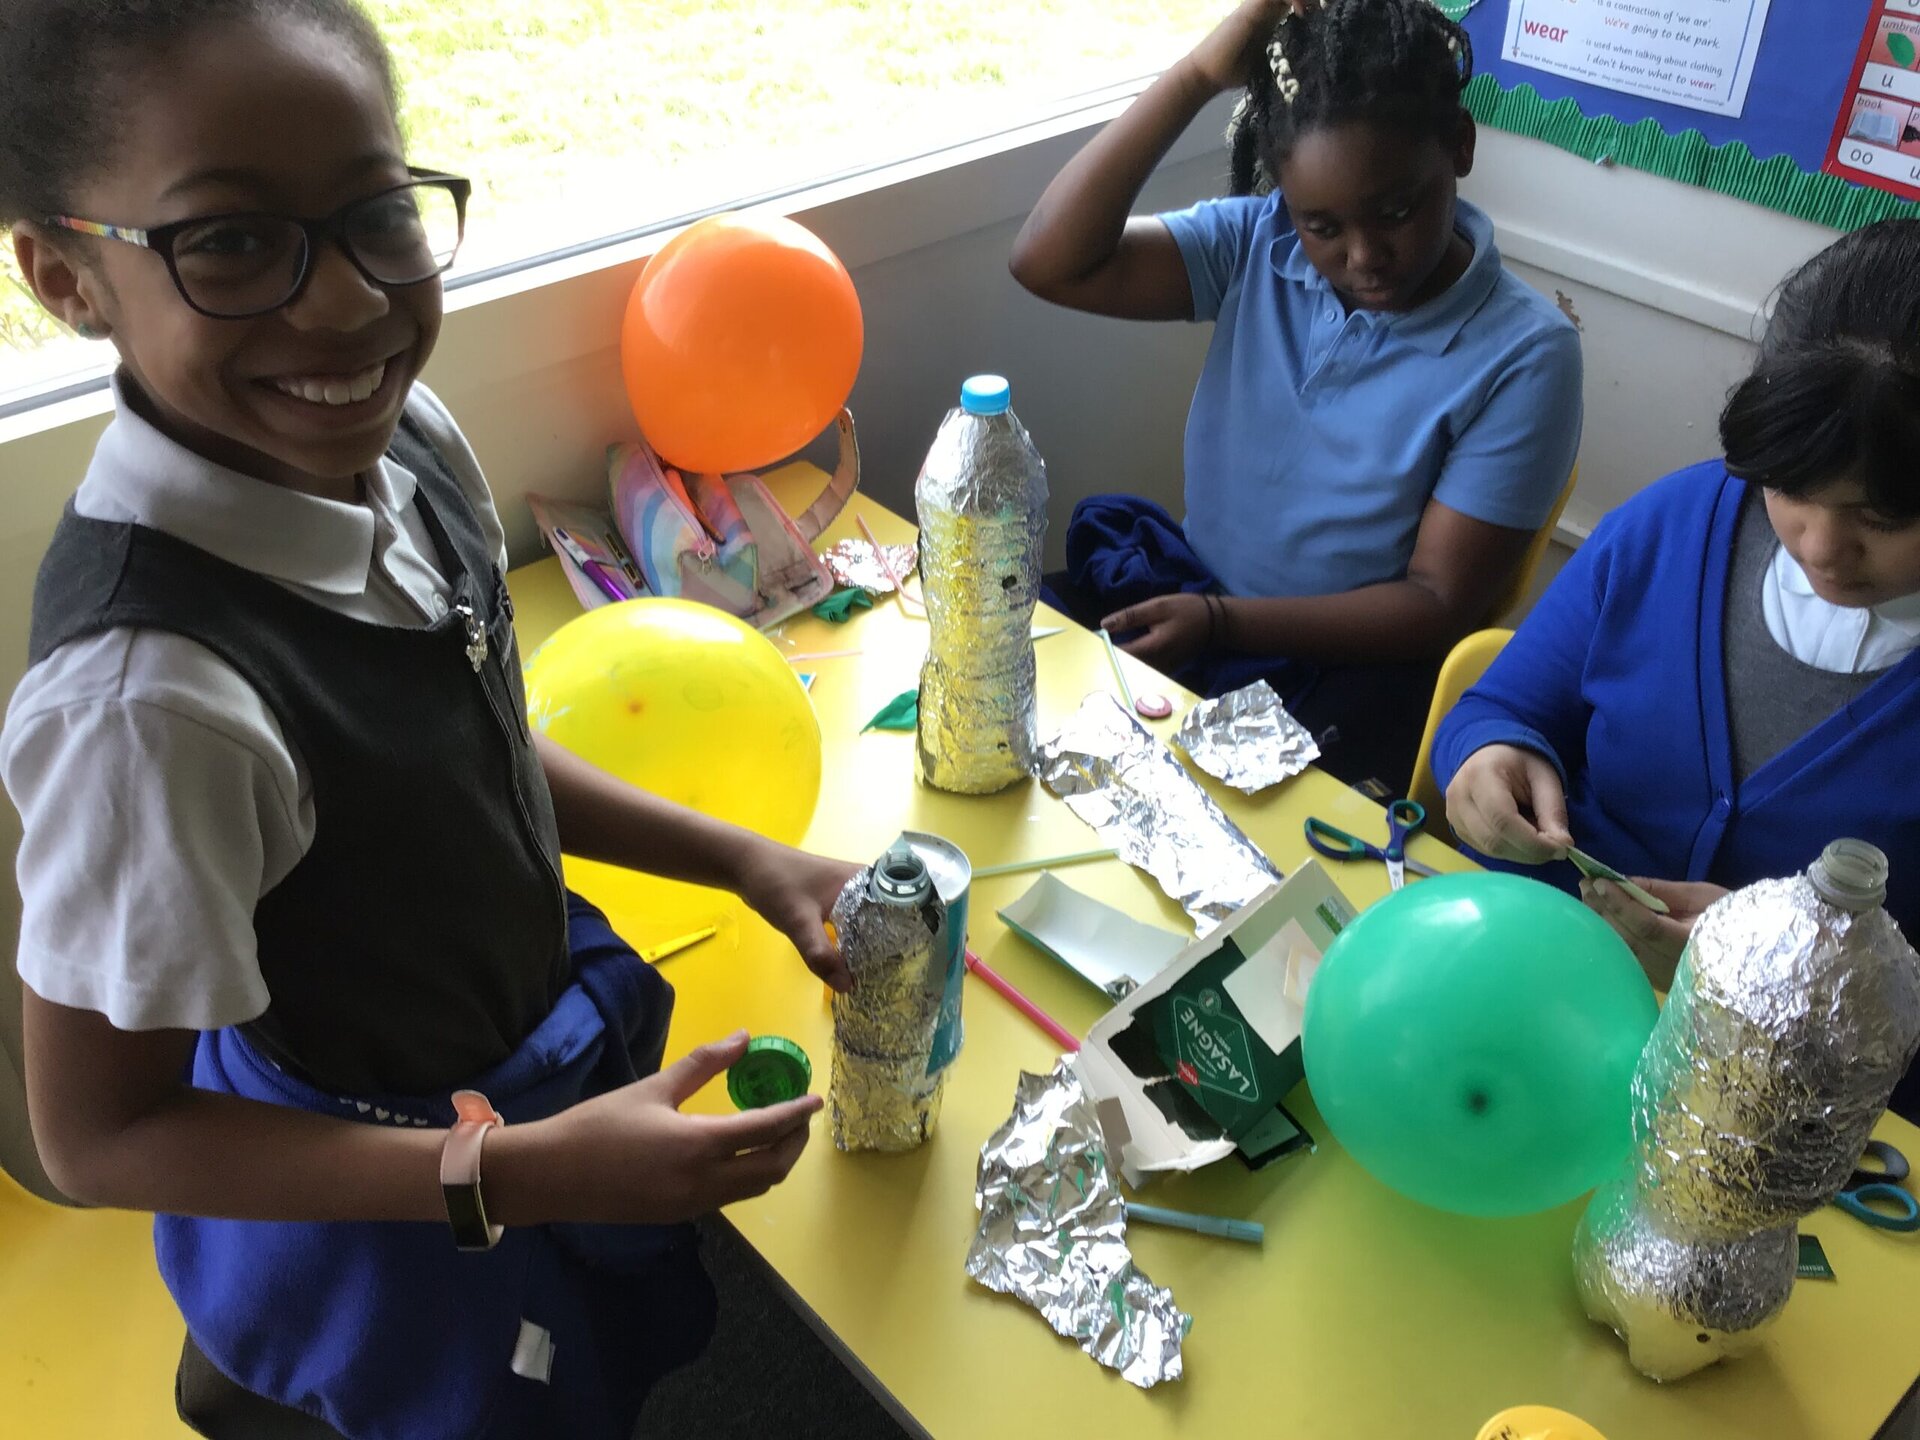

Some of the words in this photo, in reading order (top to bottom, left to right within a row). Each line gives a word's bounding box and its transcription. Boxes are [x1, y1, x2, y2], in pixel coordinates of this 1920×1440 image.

[1614, 2, 1661, 18] contraction
[1663, 11, 1673, 24] of
[1524, 19, 1568, 43] wear
[1604, 16, 1630, 29] We're
[1632, 24, 1659, 39] going
[1661, 29, 1672, 39] to
[1675, 31, 1691, 42] the
[1693, 36, 1720, 49] park.
[1592, 55, 1616, 69] don't
[1619, 61, 1645, 75] know
[1648, 69, 1672, 81] what
[1676, 73, 1687, 84] to
[1594, 41, 1611, 51] used
[1613, 44, 1633, 56] when
[1635, 49, 1662, 65] talking
[1664, 55, 1688, 67] about
[1690, 60, 1722, 78] clothing
[1881, 72, 1894, 89] u
[1857, 96, 1882, 110] book
[1850, 148, 1874, 165] oo
[1180, 1006, 1250, 1093] LASAGNE
